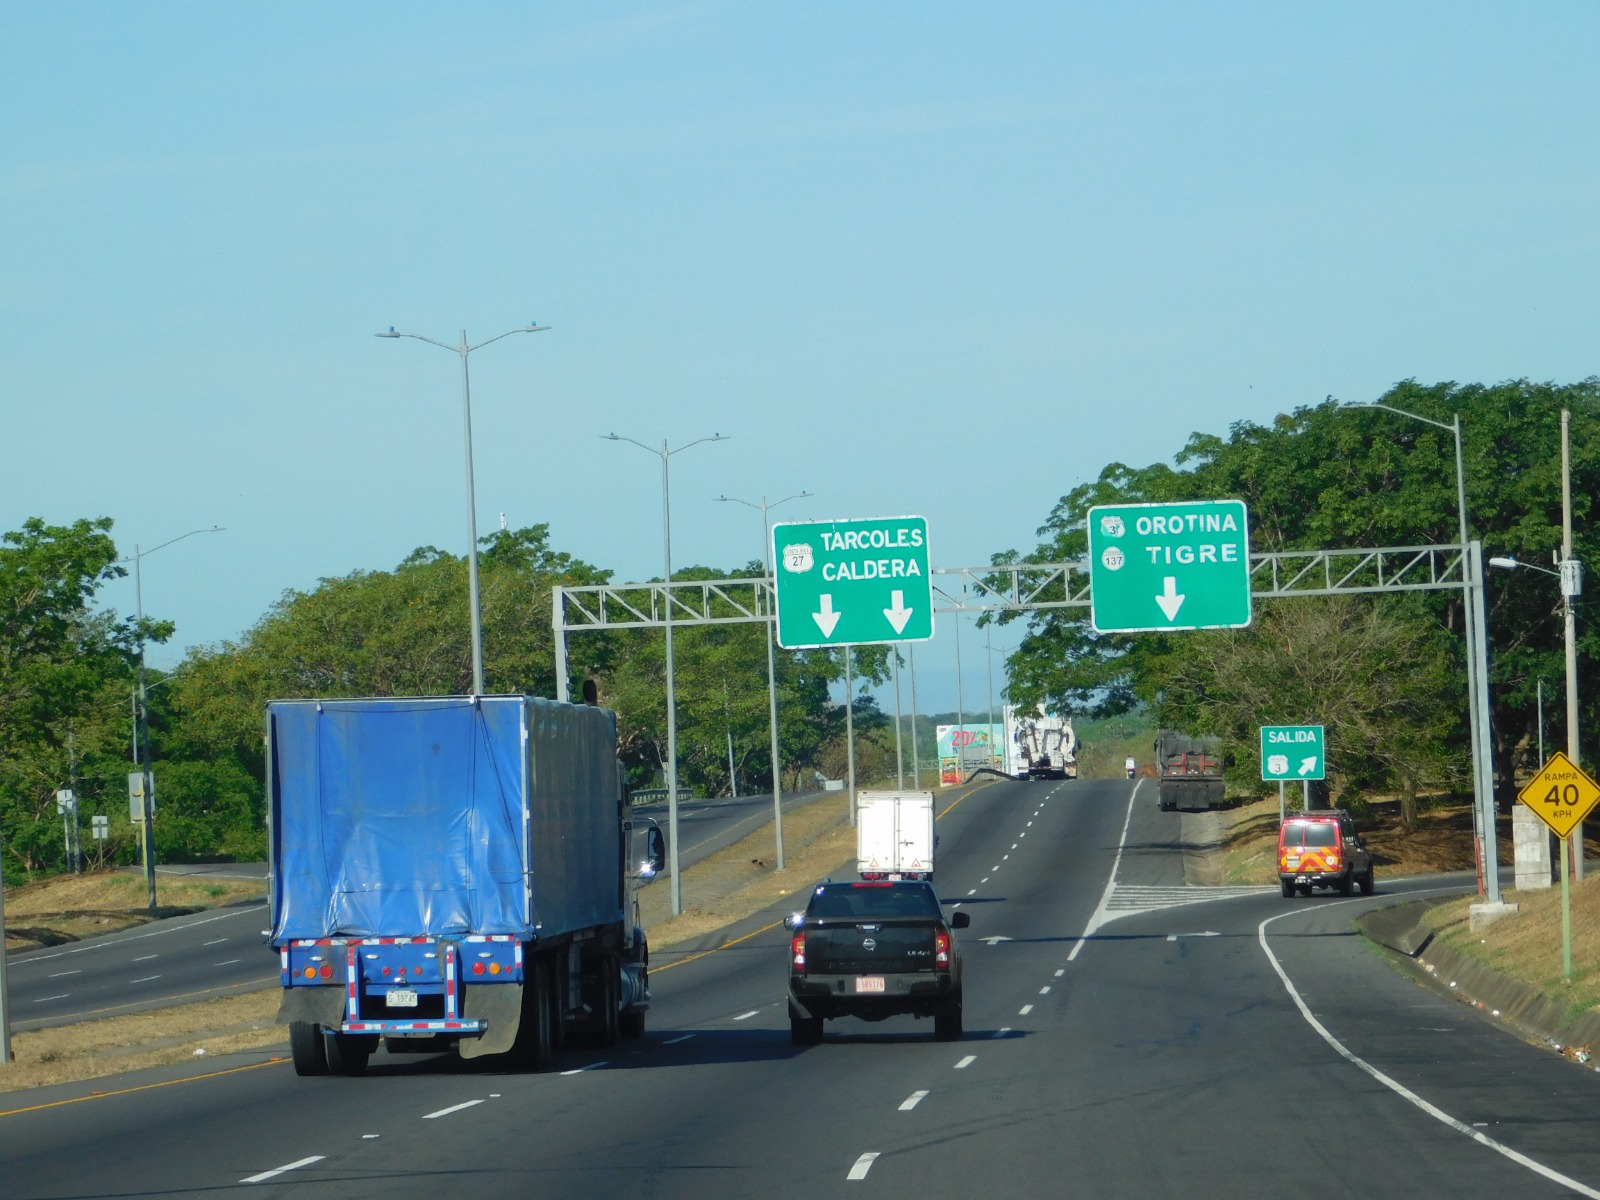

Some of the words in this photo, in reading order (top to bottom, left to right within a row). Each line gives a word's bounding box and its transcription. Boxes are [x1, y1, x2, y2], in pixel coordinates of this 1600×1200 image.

[1110, 525, 1116, 534] 3
[1136, 513, 1238, 535] OROTINA
[820, 528, 923, 551] TARCOLES
[1145, 543, 1238, 564] TIGRE
[792, 555, 804, 566] 27
[1105, 556, 1123, 566] 137
[822, 558, 921, 581] CALDERA
[1269, 730, 1316, 743] SALIDA
[1275, 764, 1281, 772] 3
[1545, 772, 1578, 781] RAMPA
[1544, 784, 1579, 806] 40
[1553, 810, 1571, 818] KPH
